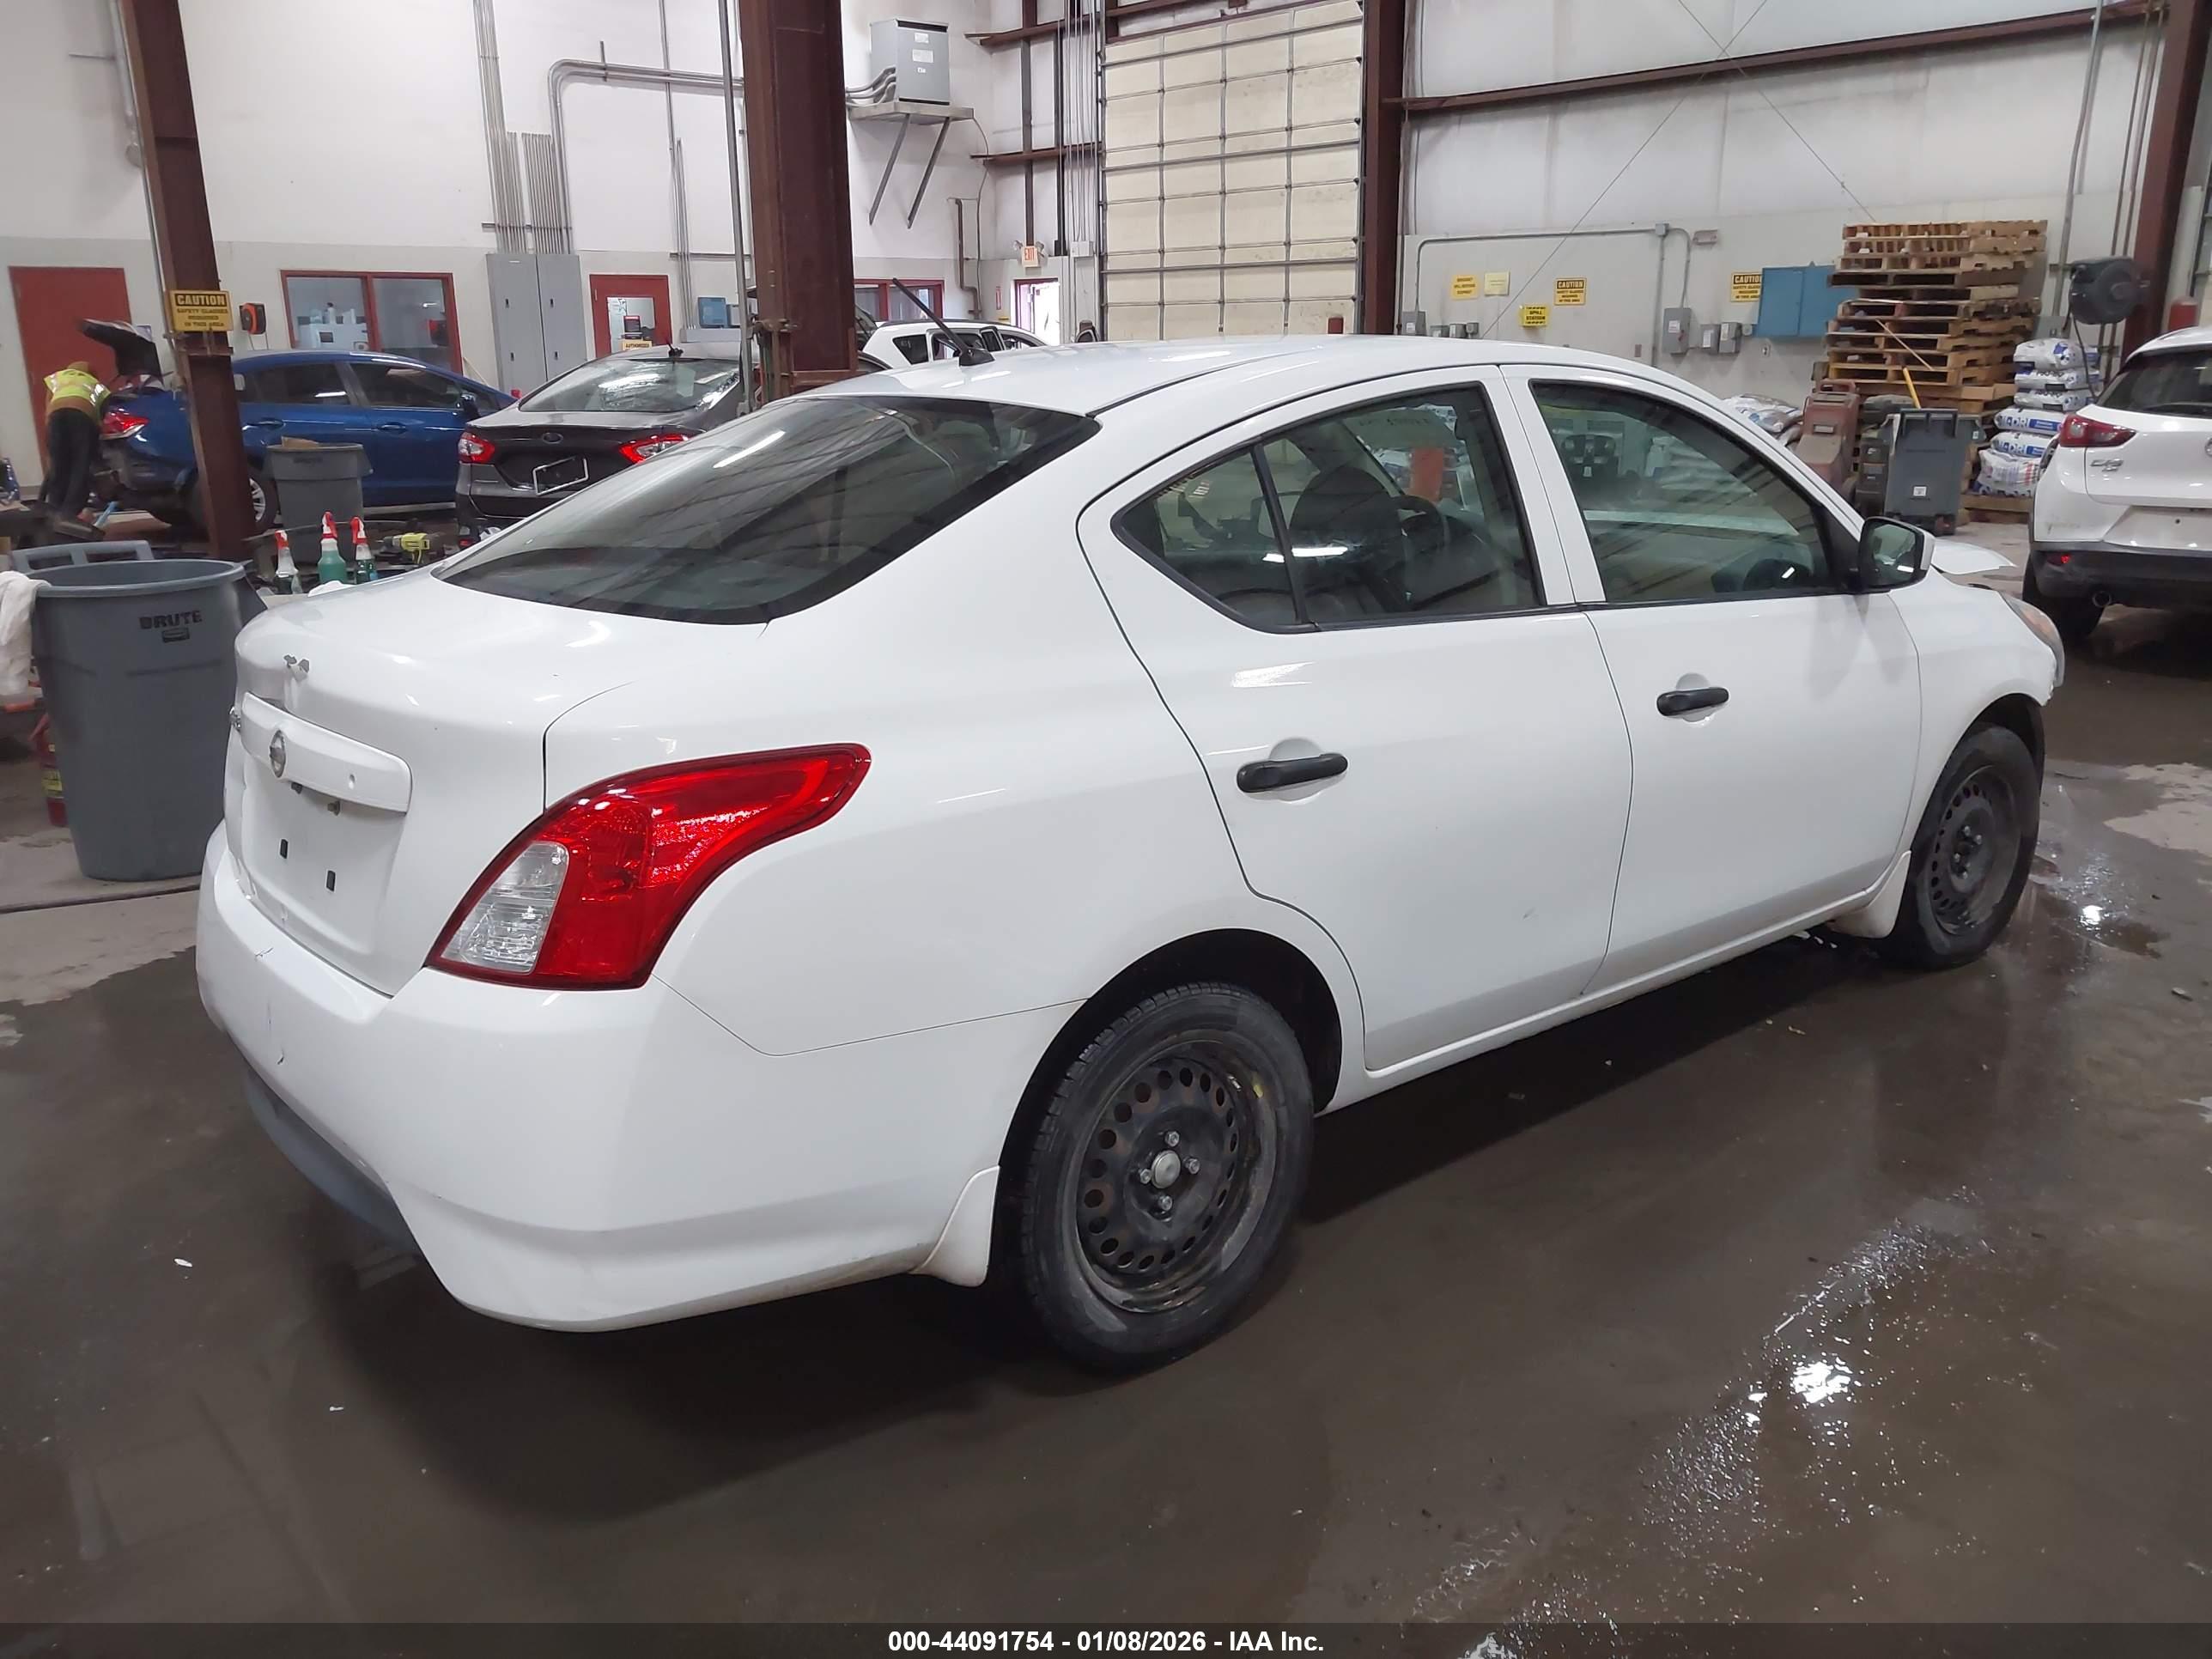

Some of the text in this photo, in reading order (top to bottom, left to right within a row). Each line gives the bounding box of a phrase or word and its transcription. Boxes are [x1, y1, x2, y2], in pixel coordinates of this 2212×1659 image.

[1024, 247, 1035, 261] EXIT
[177, 295, 225, 306] CAUTION
[138, 610, 203, 630] BRUTE
